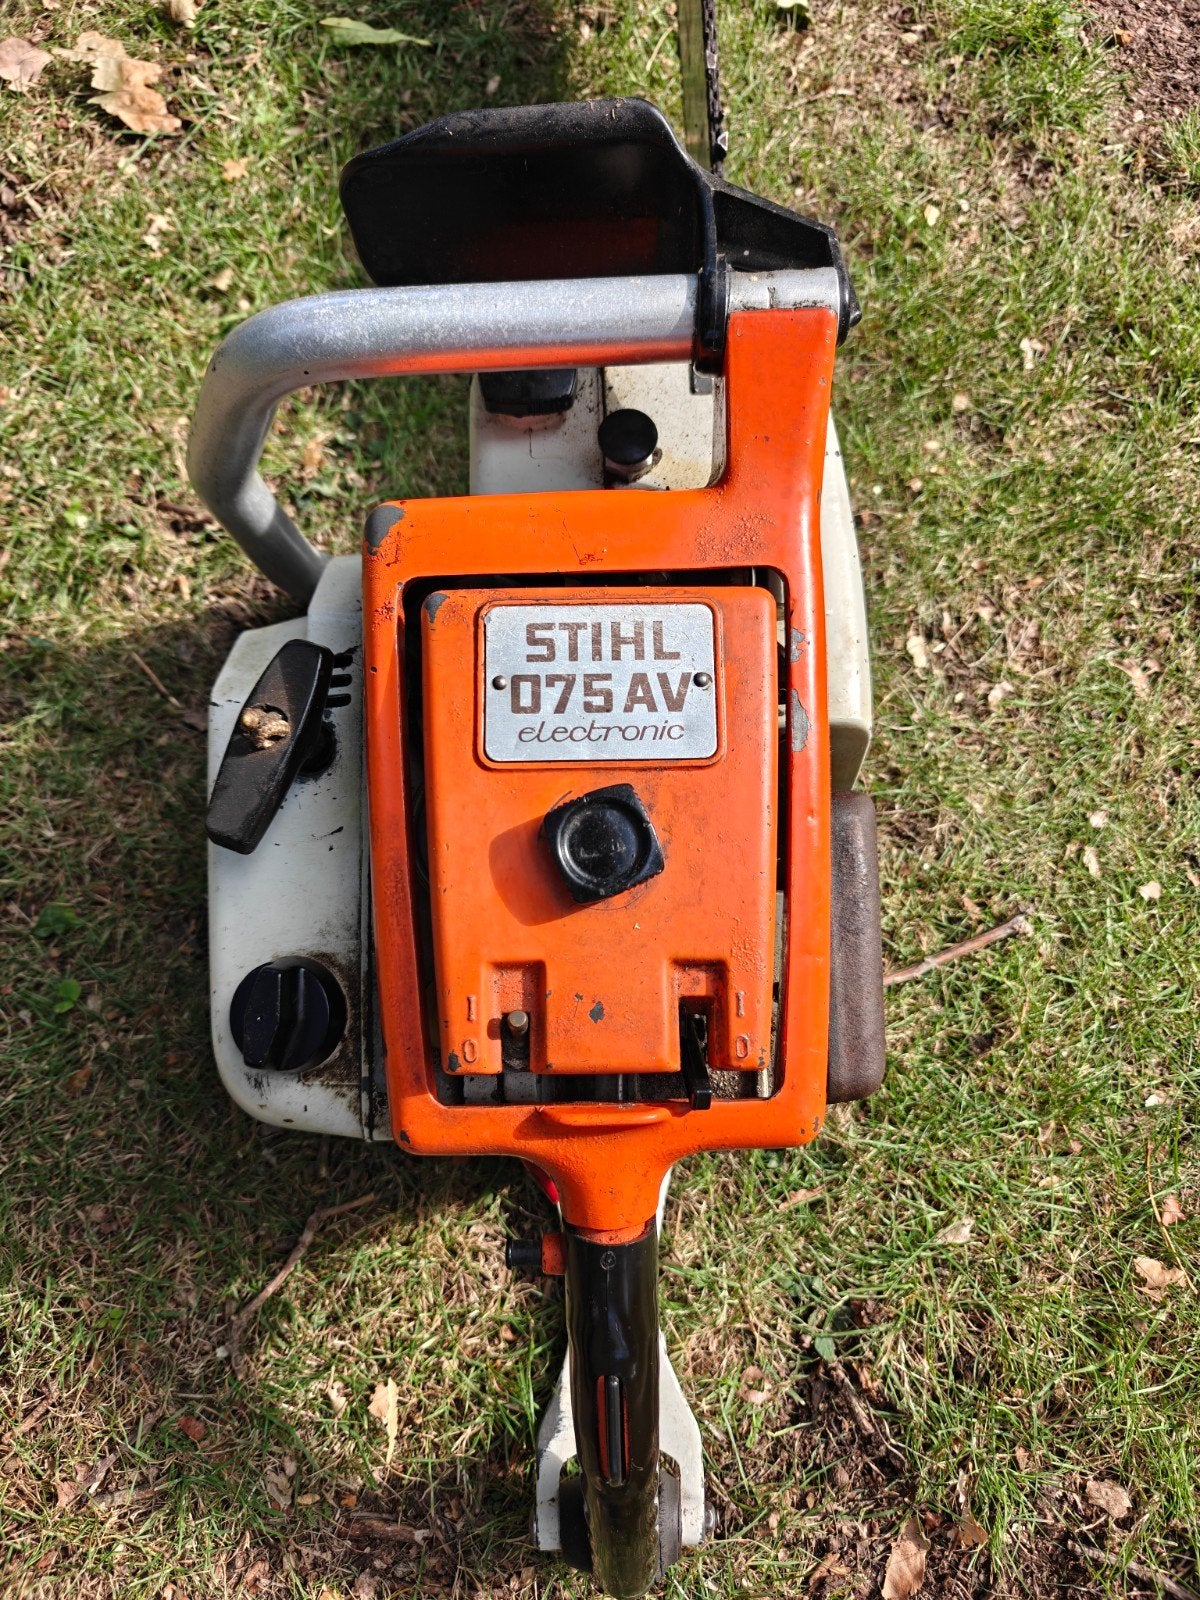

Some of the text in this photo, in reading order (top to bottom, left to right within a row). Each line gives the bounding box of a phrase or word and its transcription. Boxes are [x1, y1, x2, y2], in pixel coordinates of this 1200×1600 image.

[525, 620, 681, 663] STIHL
[510, 672, 692, 714] 075 AV
[518, 719, 685, 742] electronic
